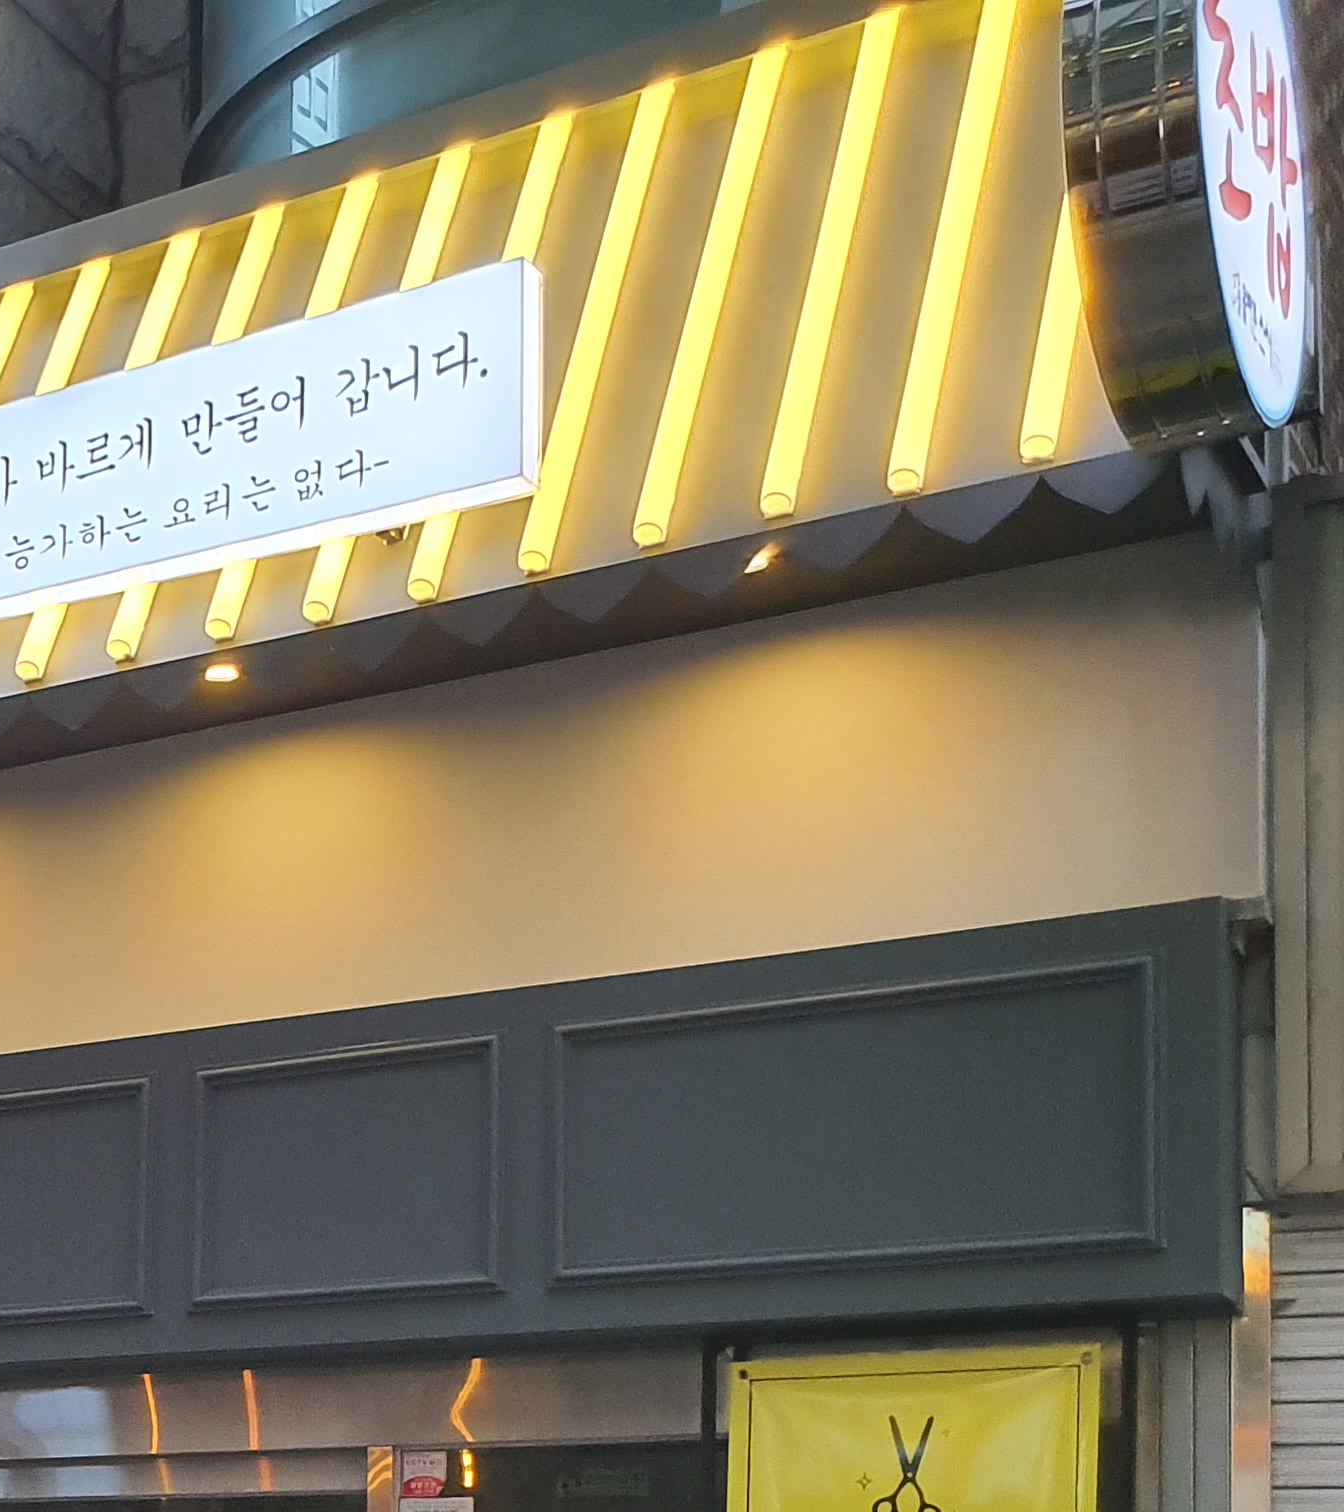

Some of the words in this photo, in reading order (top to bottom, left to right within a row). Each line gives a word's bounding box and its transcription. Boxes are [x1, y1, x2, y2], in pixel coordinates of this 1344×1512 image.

[37, 416, 154, 484] 바르게
[181, 374, 309, 456] 만들어
[336, 331, 491, 415] 갑니다.
[5, 507, 150, 572] 능가하는
[164, 473, 278, 532] 요리는
